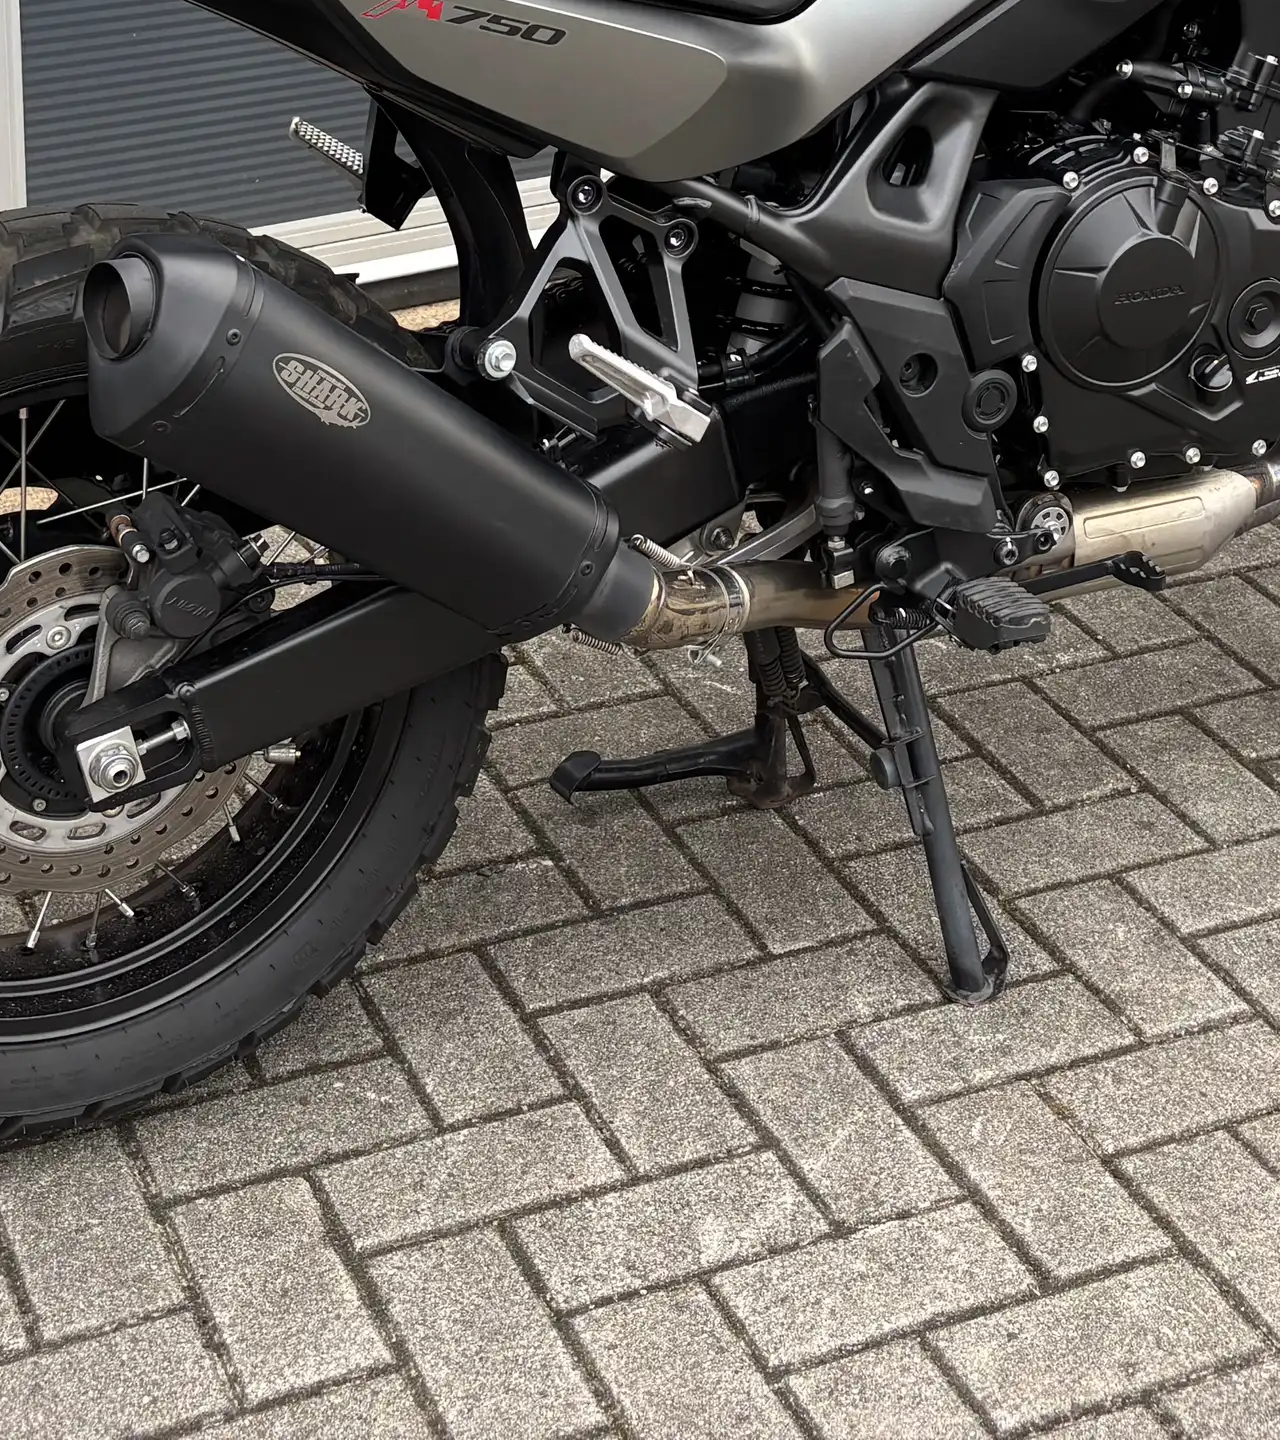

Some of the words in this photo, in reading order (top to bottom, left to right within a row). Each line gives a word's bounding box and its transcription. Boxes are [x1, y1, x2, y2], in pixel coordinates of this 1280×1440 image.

[446, 5, 568, 46] 750
[1114, 285, 1187, 305] HONDA
[278, 360, 367, 421] SHARK
